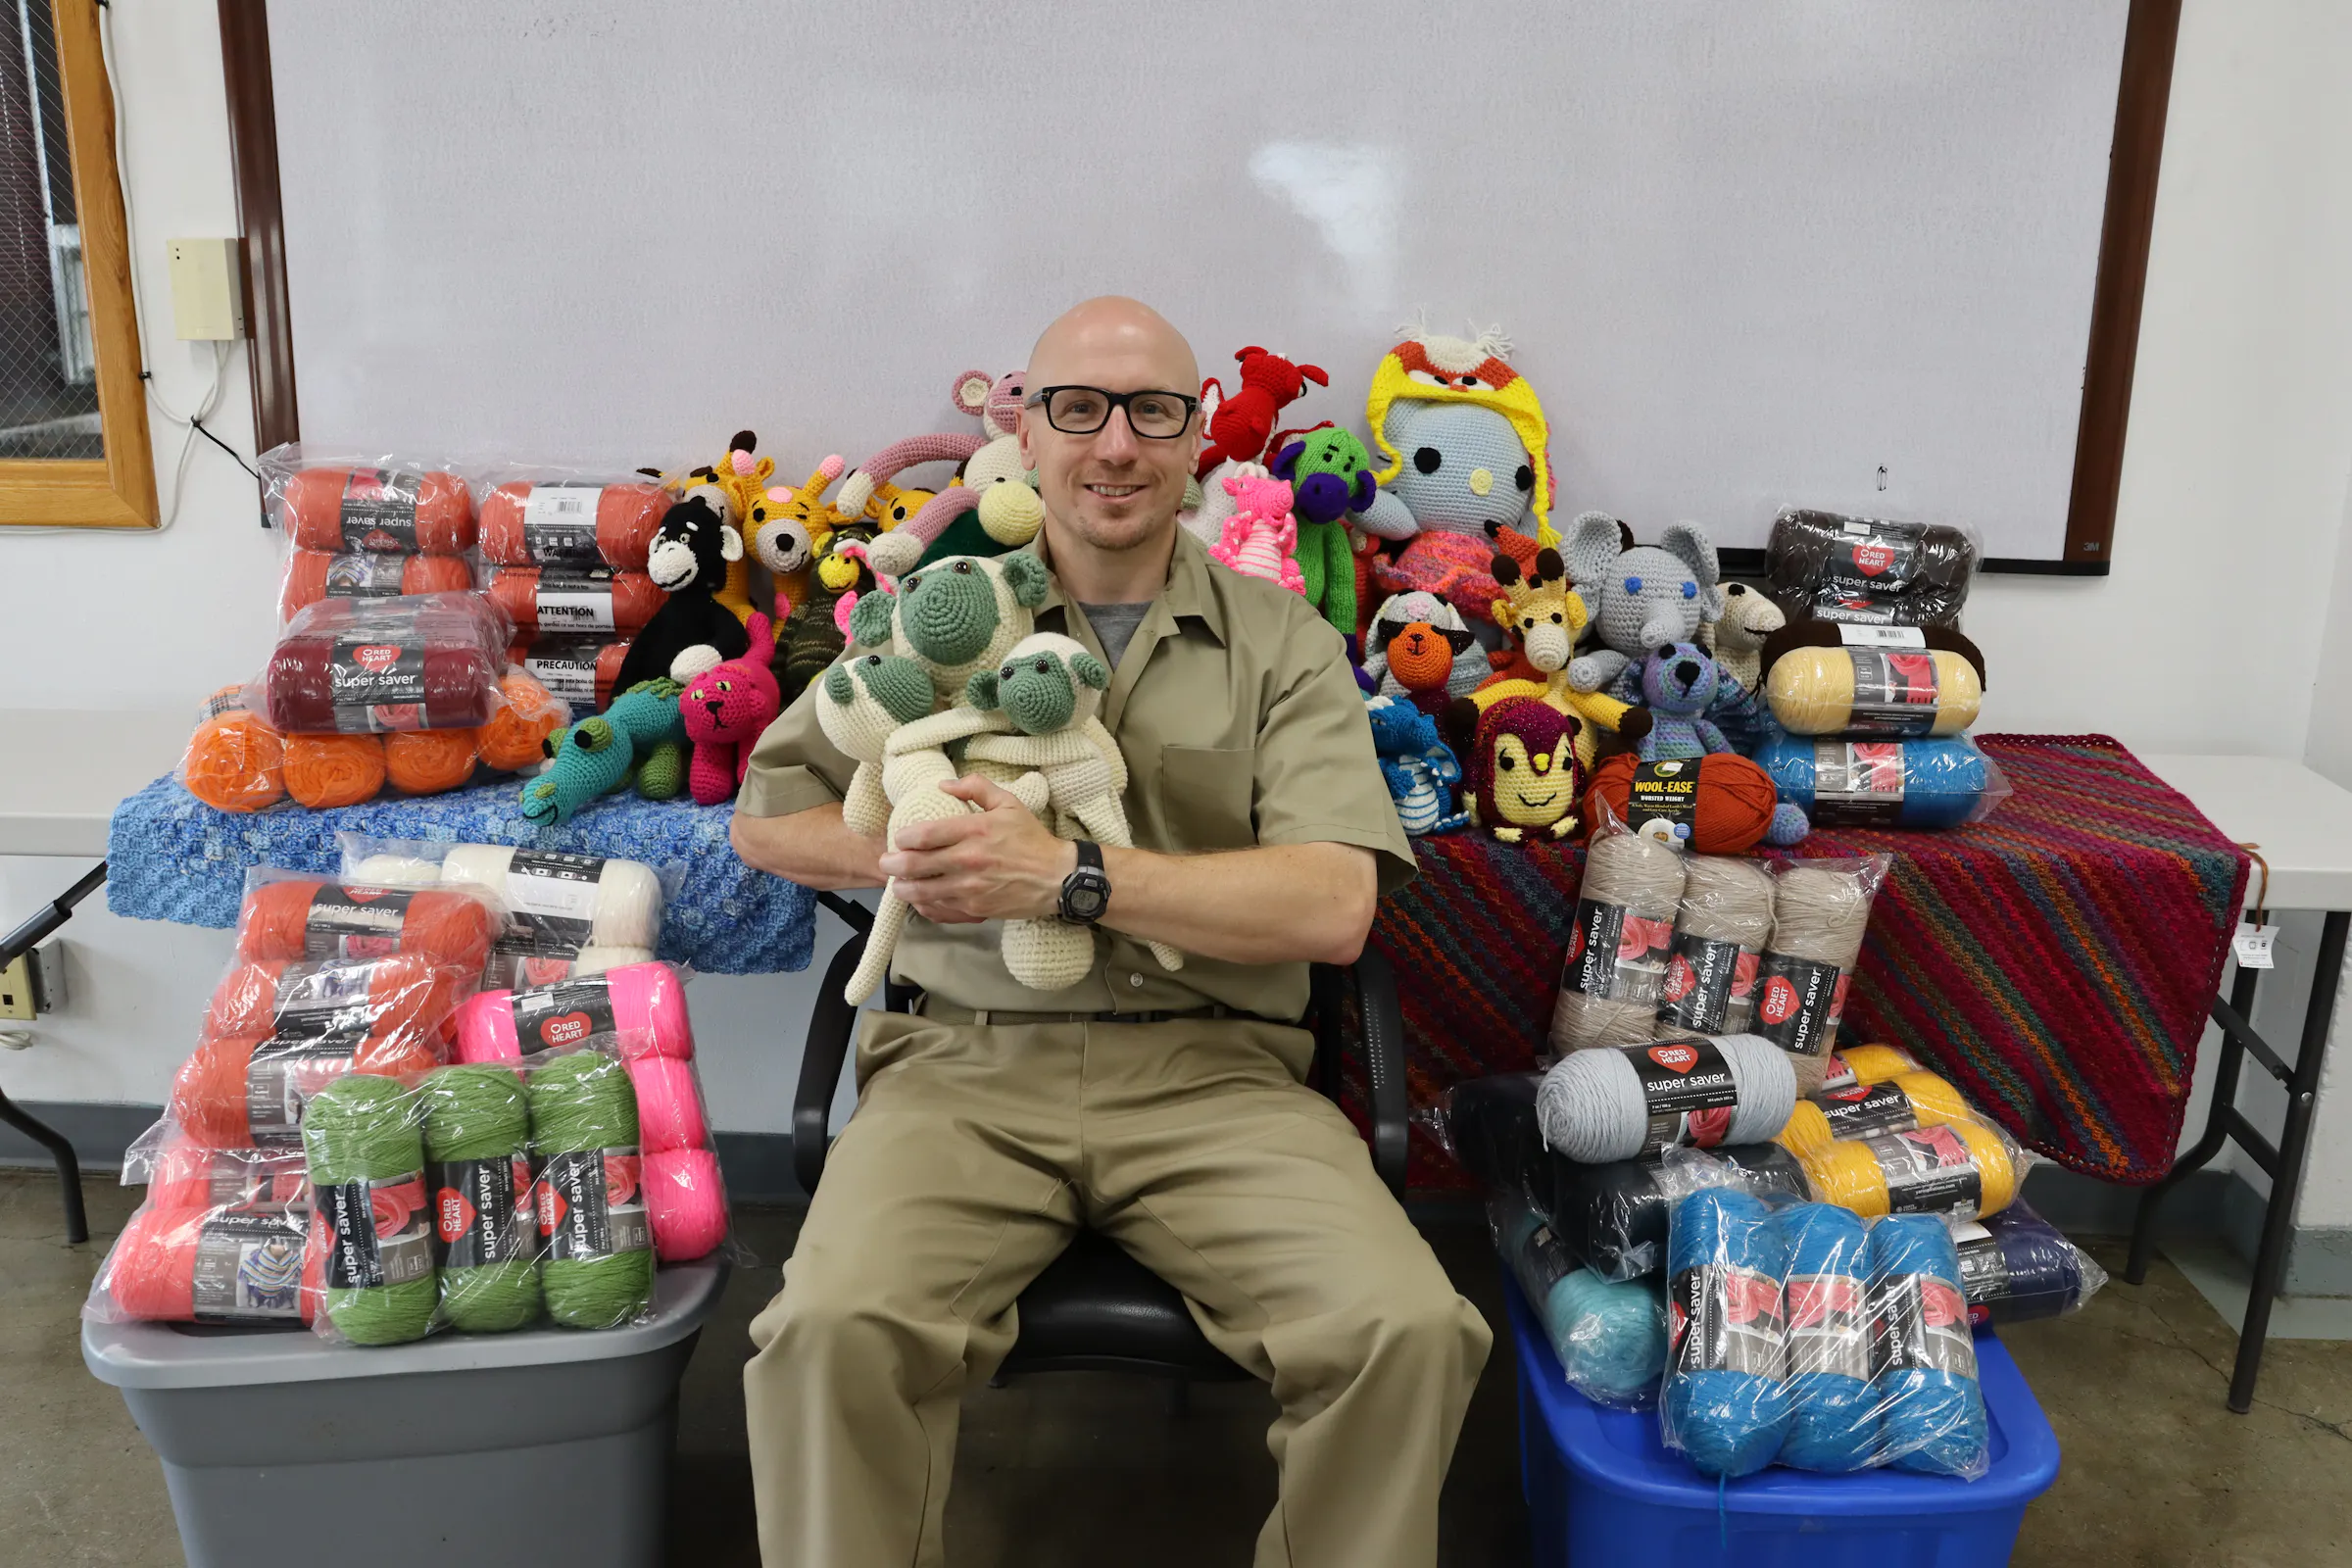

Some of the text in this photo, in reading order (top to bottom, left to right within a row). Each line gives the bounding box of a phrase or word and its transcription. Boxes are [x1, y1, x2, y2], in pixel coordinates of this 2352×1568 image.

[346, 515, 412, 527] super saver
[2083, 542, 2100, 552] 3M
[1858, 558, 1886, 566] HEART
[1833, 575, 1902, 592] super saver
[537, 606, 594, 616] ATTENTION
[1817, 610, 1886, 624] super saver
[537, 660, 597, 670] PRECAUTION
[335, 674, 416, 688] super saver
[1635, 781, 1693, 794] WOOL-EASE
[316, 903, 399, 917] super saver
[1570, 930, 1579, 957] HEART
[1580, 908, 1603, 990] super saver
[1674, 964, 1685, 995] HEART
[1692, 947, 1717, 1028] super saver
[1770, 986, 1780, 1004] RED
[1775, 987, 1788, 1017] HEART
[1794, 968, 1822, 1050] super saver
[562, 1021, 581, 1031] RED
[552, 1029, 583, 1044] HEART
[1661, 1054, 1691, 1064] HEART
[1647, 1072, 1725, 1092] super saver
[1837, 1088, 1865, 1098] HEART
[1825, 1094, 1899, 1117] super saver
[568, 1160, 582, 1203] saver
[443, 1200, 452, 1219] RED
[451, 1199, 462, 1232] HEART
[479, 1167, 497, 1259] super saver
[546, 1192, 555, 1225] HEART
[210, 1215, 258, 1226] super
[334, 1194, 360, 1284] super saver
[1690, 1274, 1703, 1365] super saver
[1885, 1284, 1903, 1366] super saer
